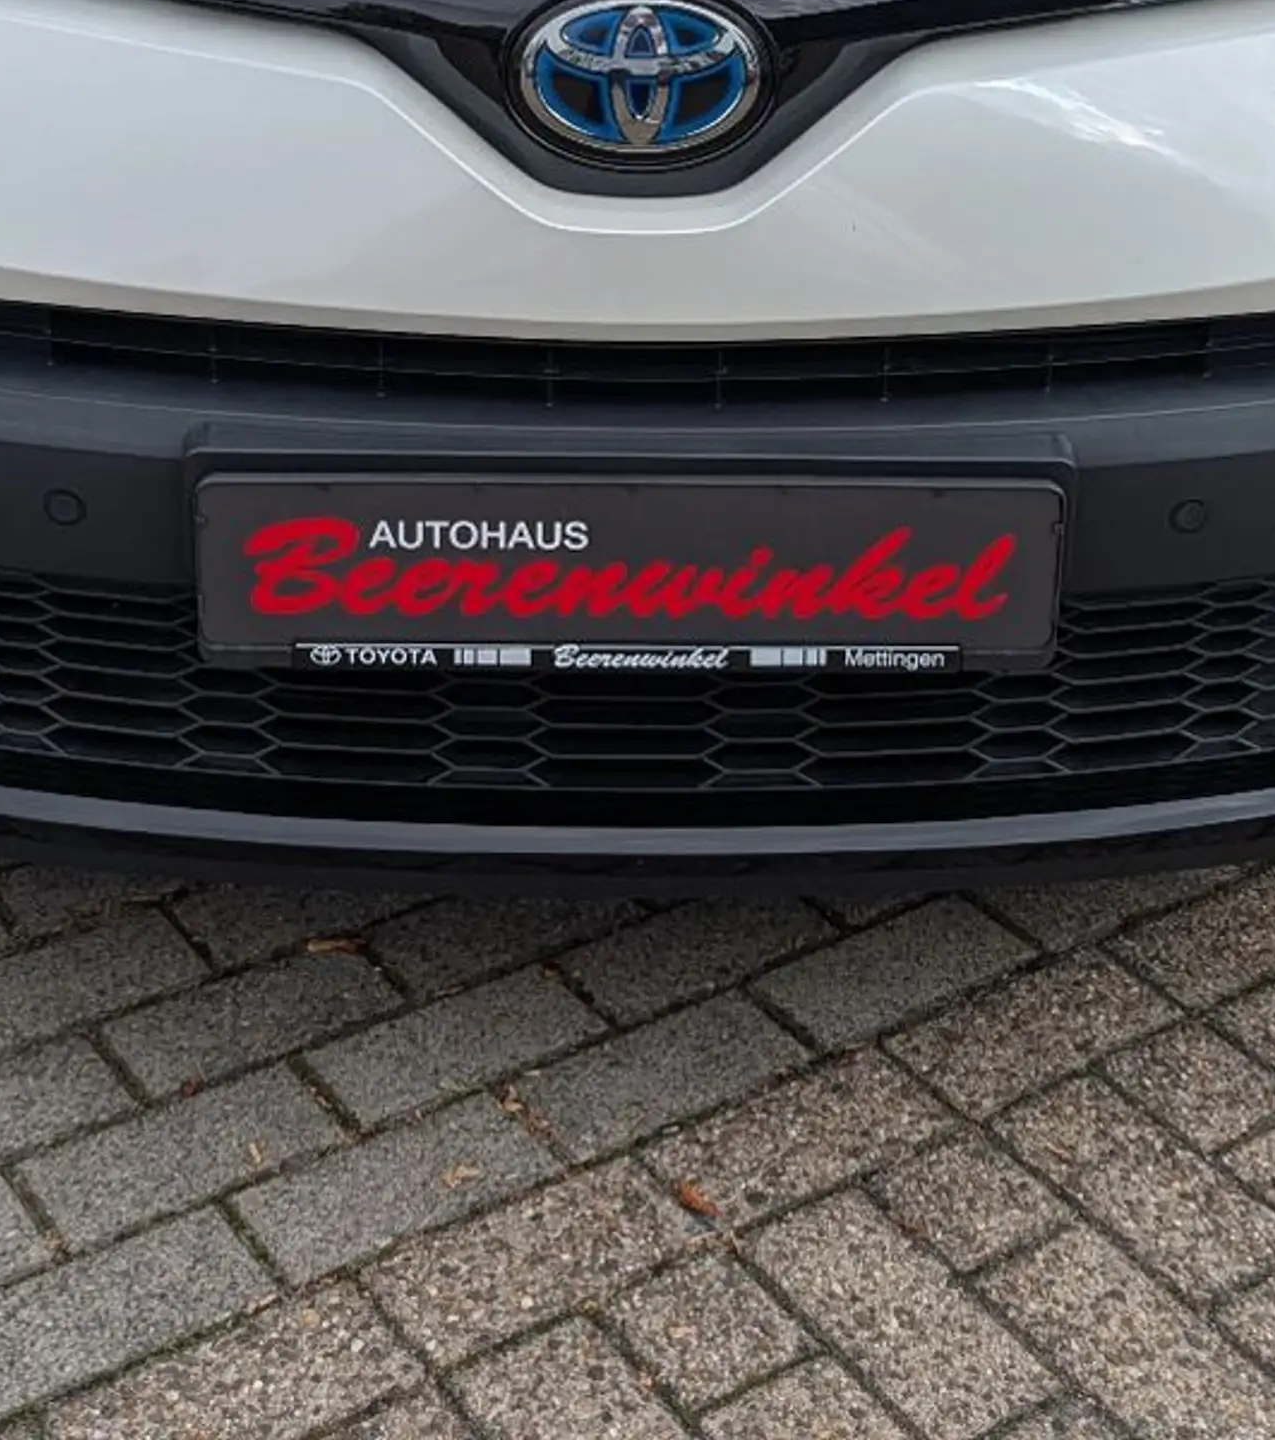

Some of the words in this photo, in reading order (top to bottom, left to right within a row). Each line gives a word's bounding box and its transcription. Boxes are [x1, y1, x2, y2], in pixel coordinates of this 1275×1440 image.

[369, 520, 589, 551] AUTOHAUS
[244, 516, 1017, 620] Beerenwinkel
[348, 649, 437, 666] TOYOTA
[553, 643, 731, 670] Beerenwinkel
[845, 649, 946, 669] Mettingen
